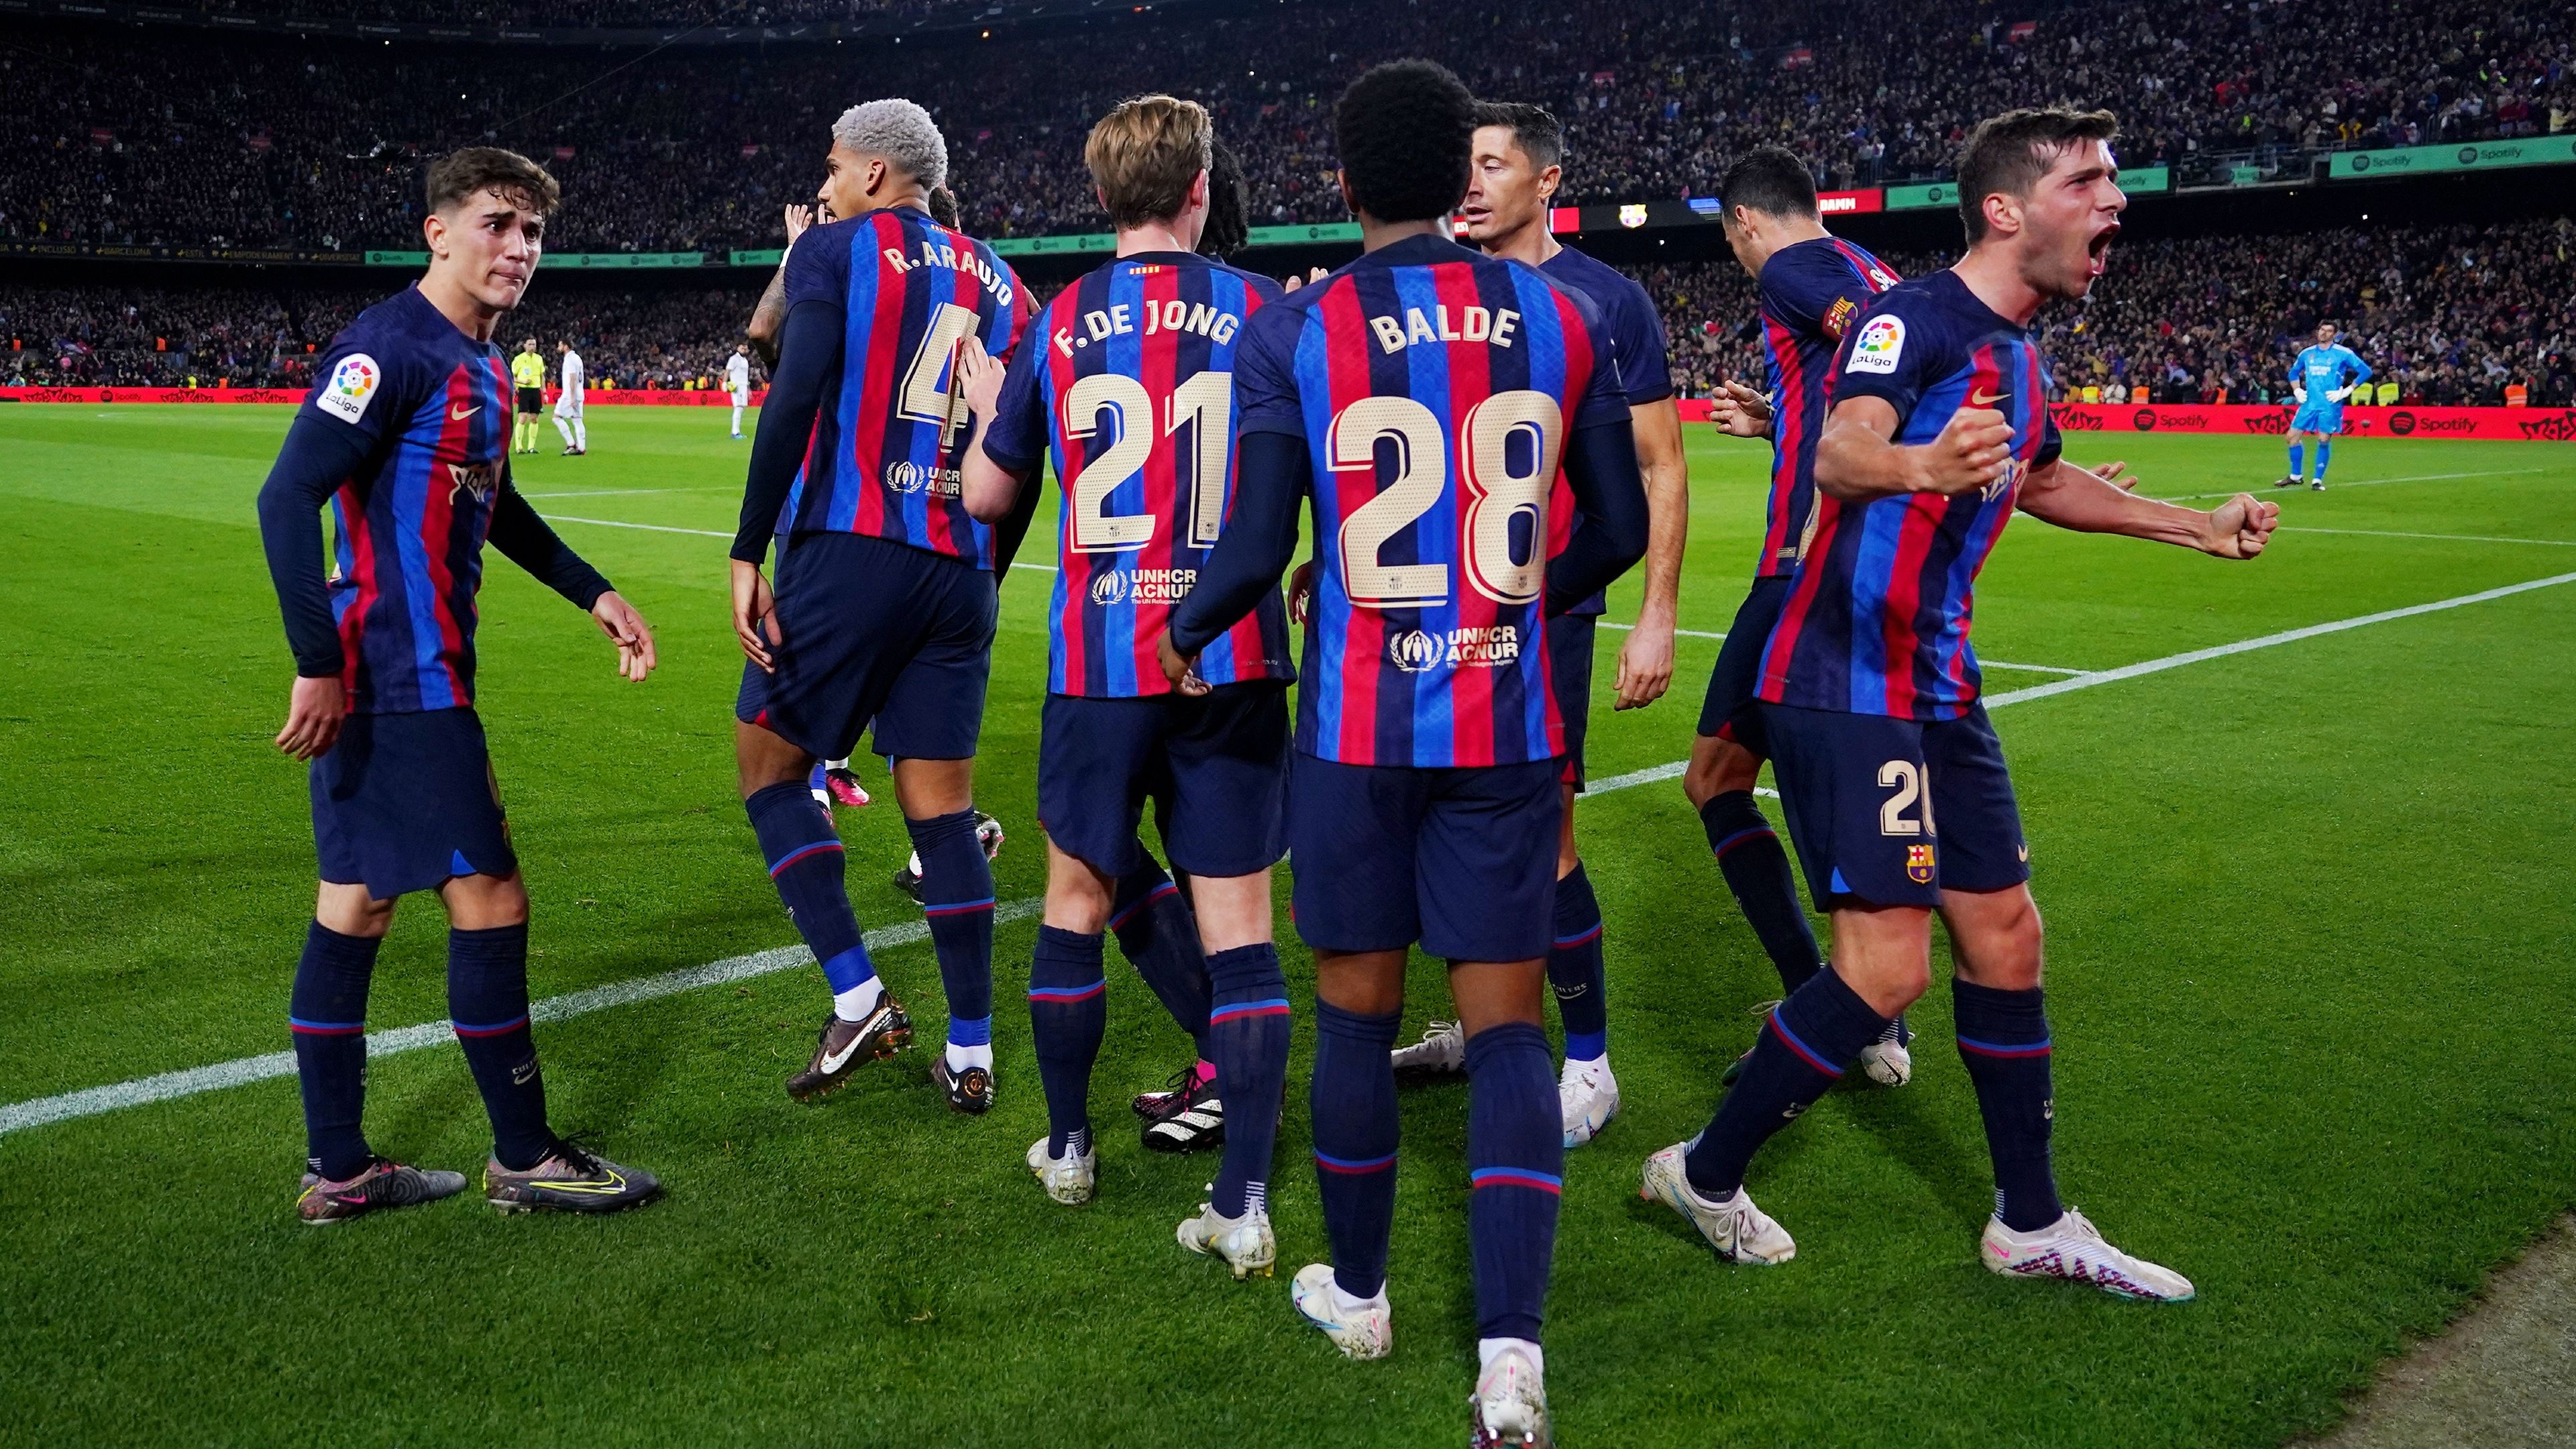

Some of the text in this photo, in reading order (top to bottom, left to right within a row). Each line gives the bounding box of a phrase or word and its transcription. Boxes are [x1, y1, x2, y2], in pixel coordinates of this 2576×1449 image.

[2481, 147, 2522, 160] Spotify
[1819, 197, 1856, 212] DAMM
[1145, 300, 1240, 345] JONG
[1369, 305, 1520, 354] BALDE
[1852, 355, 1891, 366] LaLiga
[896, 302, 980, 454] 4
[326, 393, 360, 413] LaLiga
[2161, 415, 2209, 429] Spotify
[2420, 417, 2477, 433] Spotify
[1063, 372, 1232, 553] 21
[1326, 390, 1563, 608] 28
[1130, 569, 1197, 583] UNHCR
[1448, 626, 1517, 645] UNHCR
[1446, 642, 1518, 661] ACNUR
